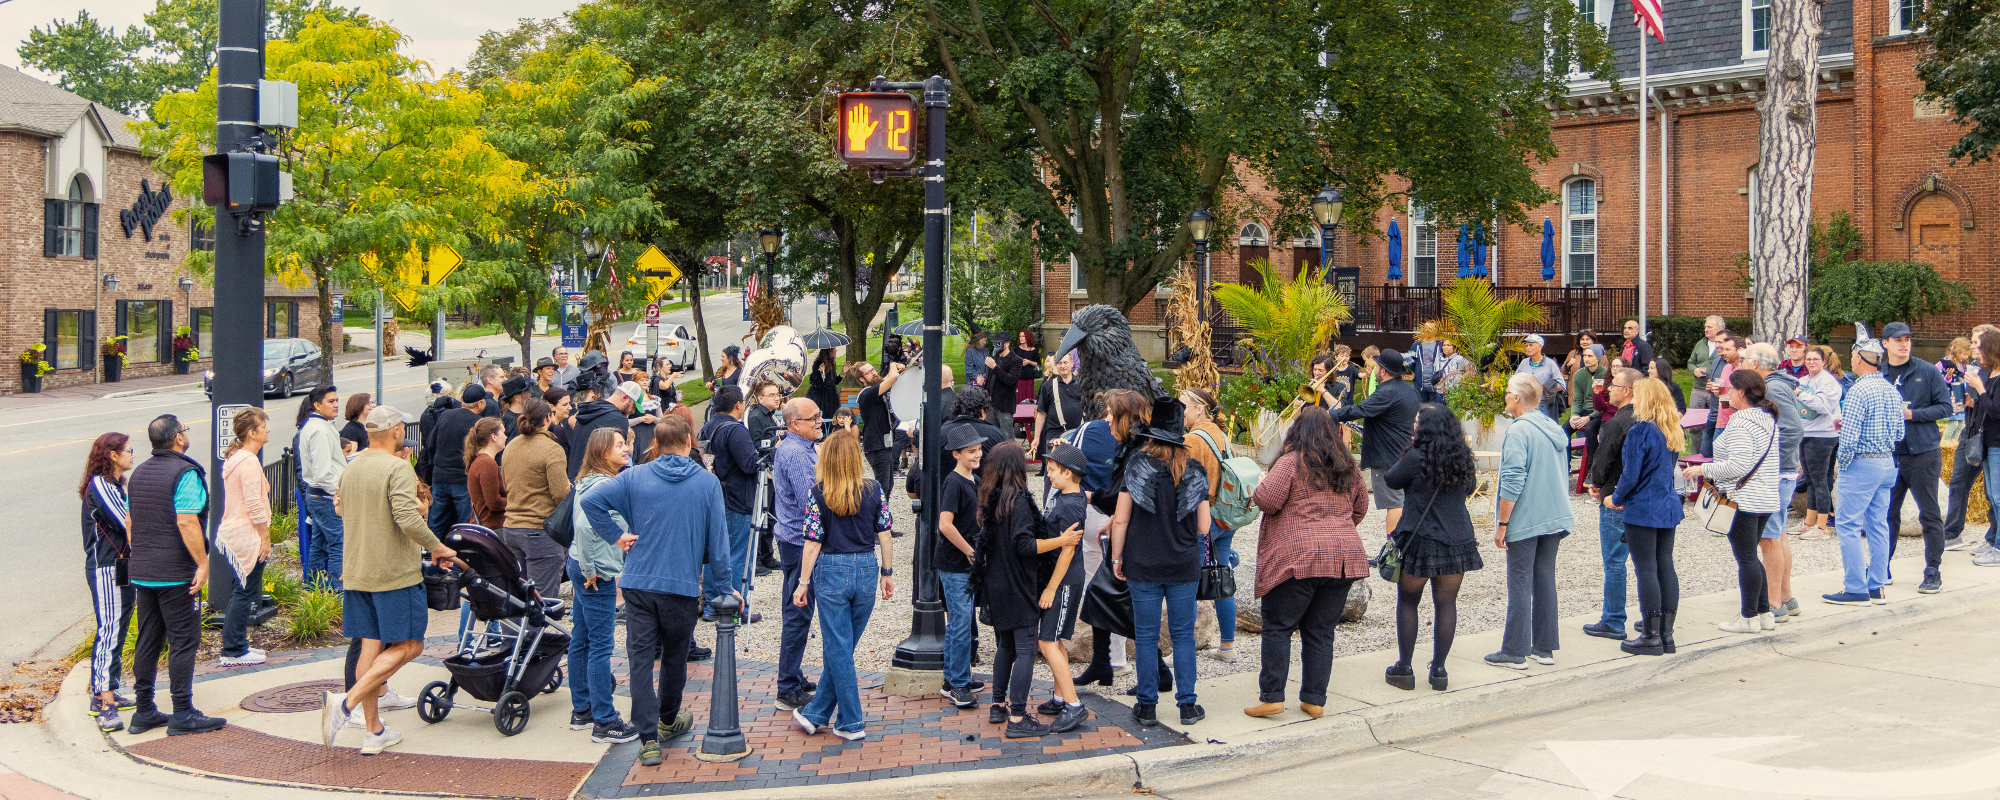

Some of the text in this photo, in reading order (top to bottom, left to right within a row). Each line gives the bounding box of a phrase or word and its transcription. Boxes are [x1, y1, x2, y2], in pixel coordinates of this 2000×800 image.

[887, 110, 910, 151] 12
[120, 179, 156, 239] focal
[141, 182, 174, 242] point
